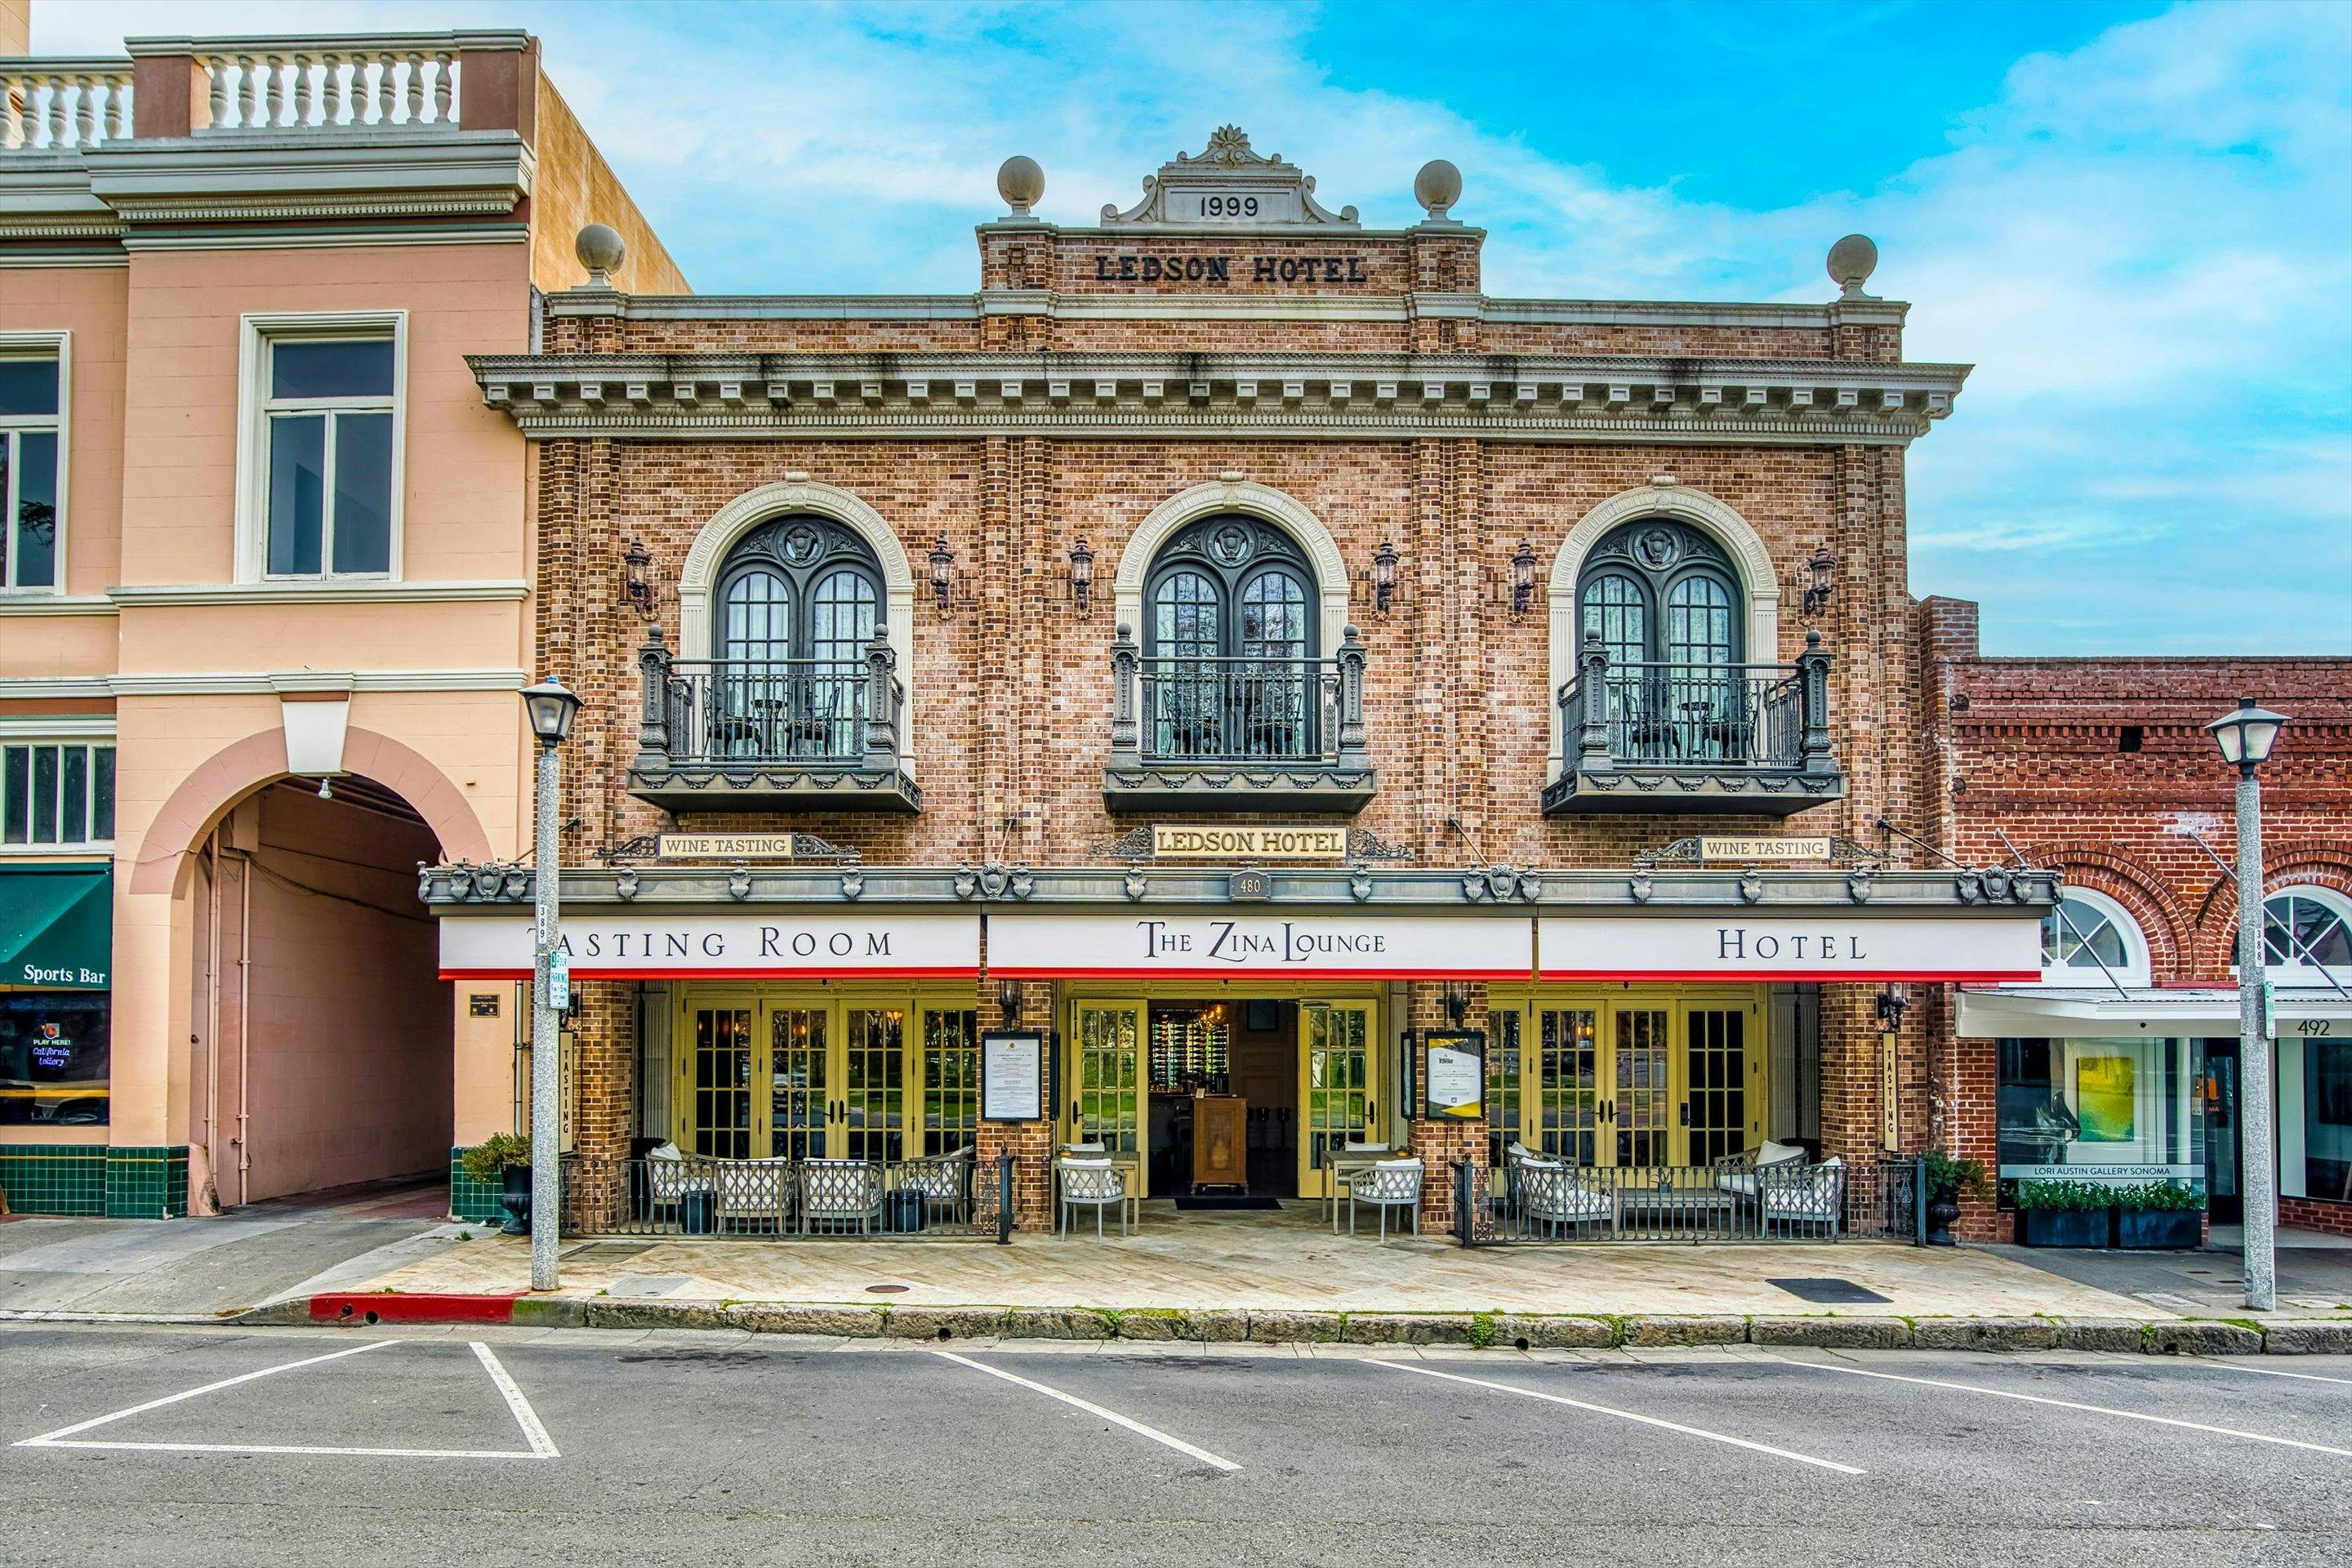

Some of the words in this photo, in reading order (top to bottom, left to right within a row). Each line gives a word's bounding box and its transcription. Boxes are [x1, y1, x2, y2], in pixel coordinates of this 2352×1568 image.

[1200, 196, 1258, 216] 1999
[1096, 256, 1230, 283] LEDSON
[1254, 256, 1368, 283] HOTEL
[666, 840, 710, 853] WINE
[715, 840, 786, 853] TASTING
[1157, 831, 1254, 853] LEDSON
[1262, 831, 1343, 852] HOTEL
[1707, 841, 1749, 855] WINE
[1755, 842, 1824, 855] TASTING
[1241, 879, 1261, 893] 480
[759, 926, 893, 957] ROOM
[1136, 920, 1192, 959] THE
[1206, 921, 1276, 962] ZINA
[1281, 922, 1386, 962] LOUNGE
[1717, 929, 1867, 959] HOTEL
[24, 964, 74, 984] Sports
[80, 968, 106, 984] Bar
[2297, 1019, 2331, 1036] 492
[2034, 1167, 2056, 1176] LORI
[2056, 1167, 2089, 1176] AUSTIN
[2090, 1167, 2128, 1176] GALLERY
[2130, 1167, 2171, 1176] SONOMA
